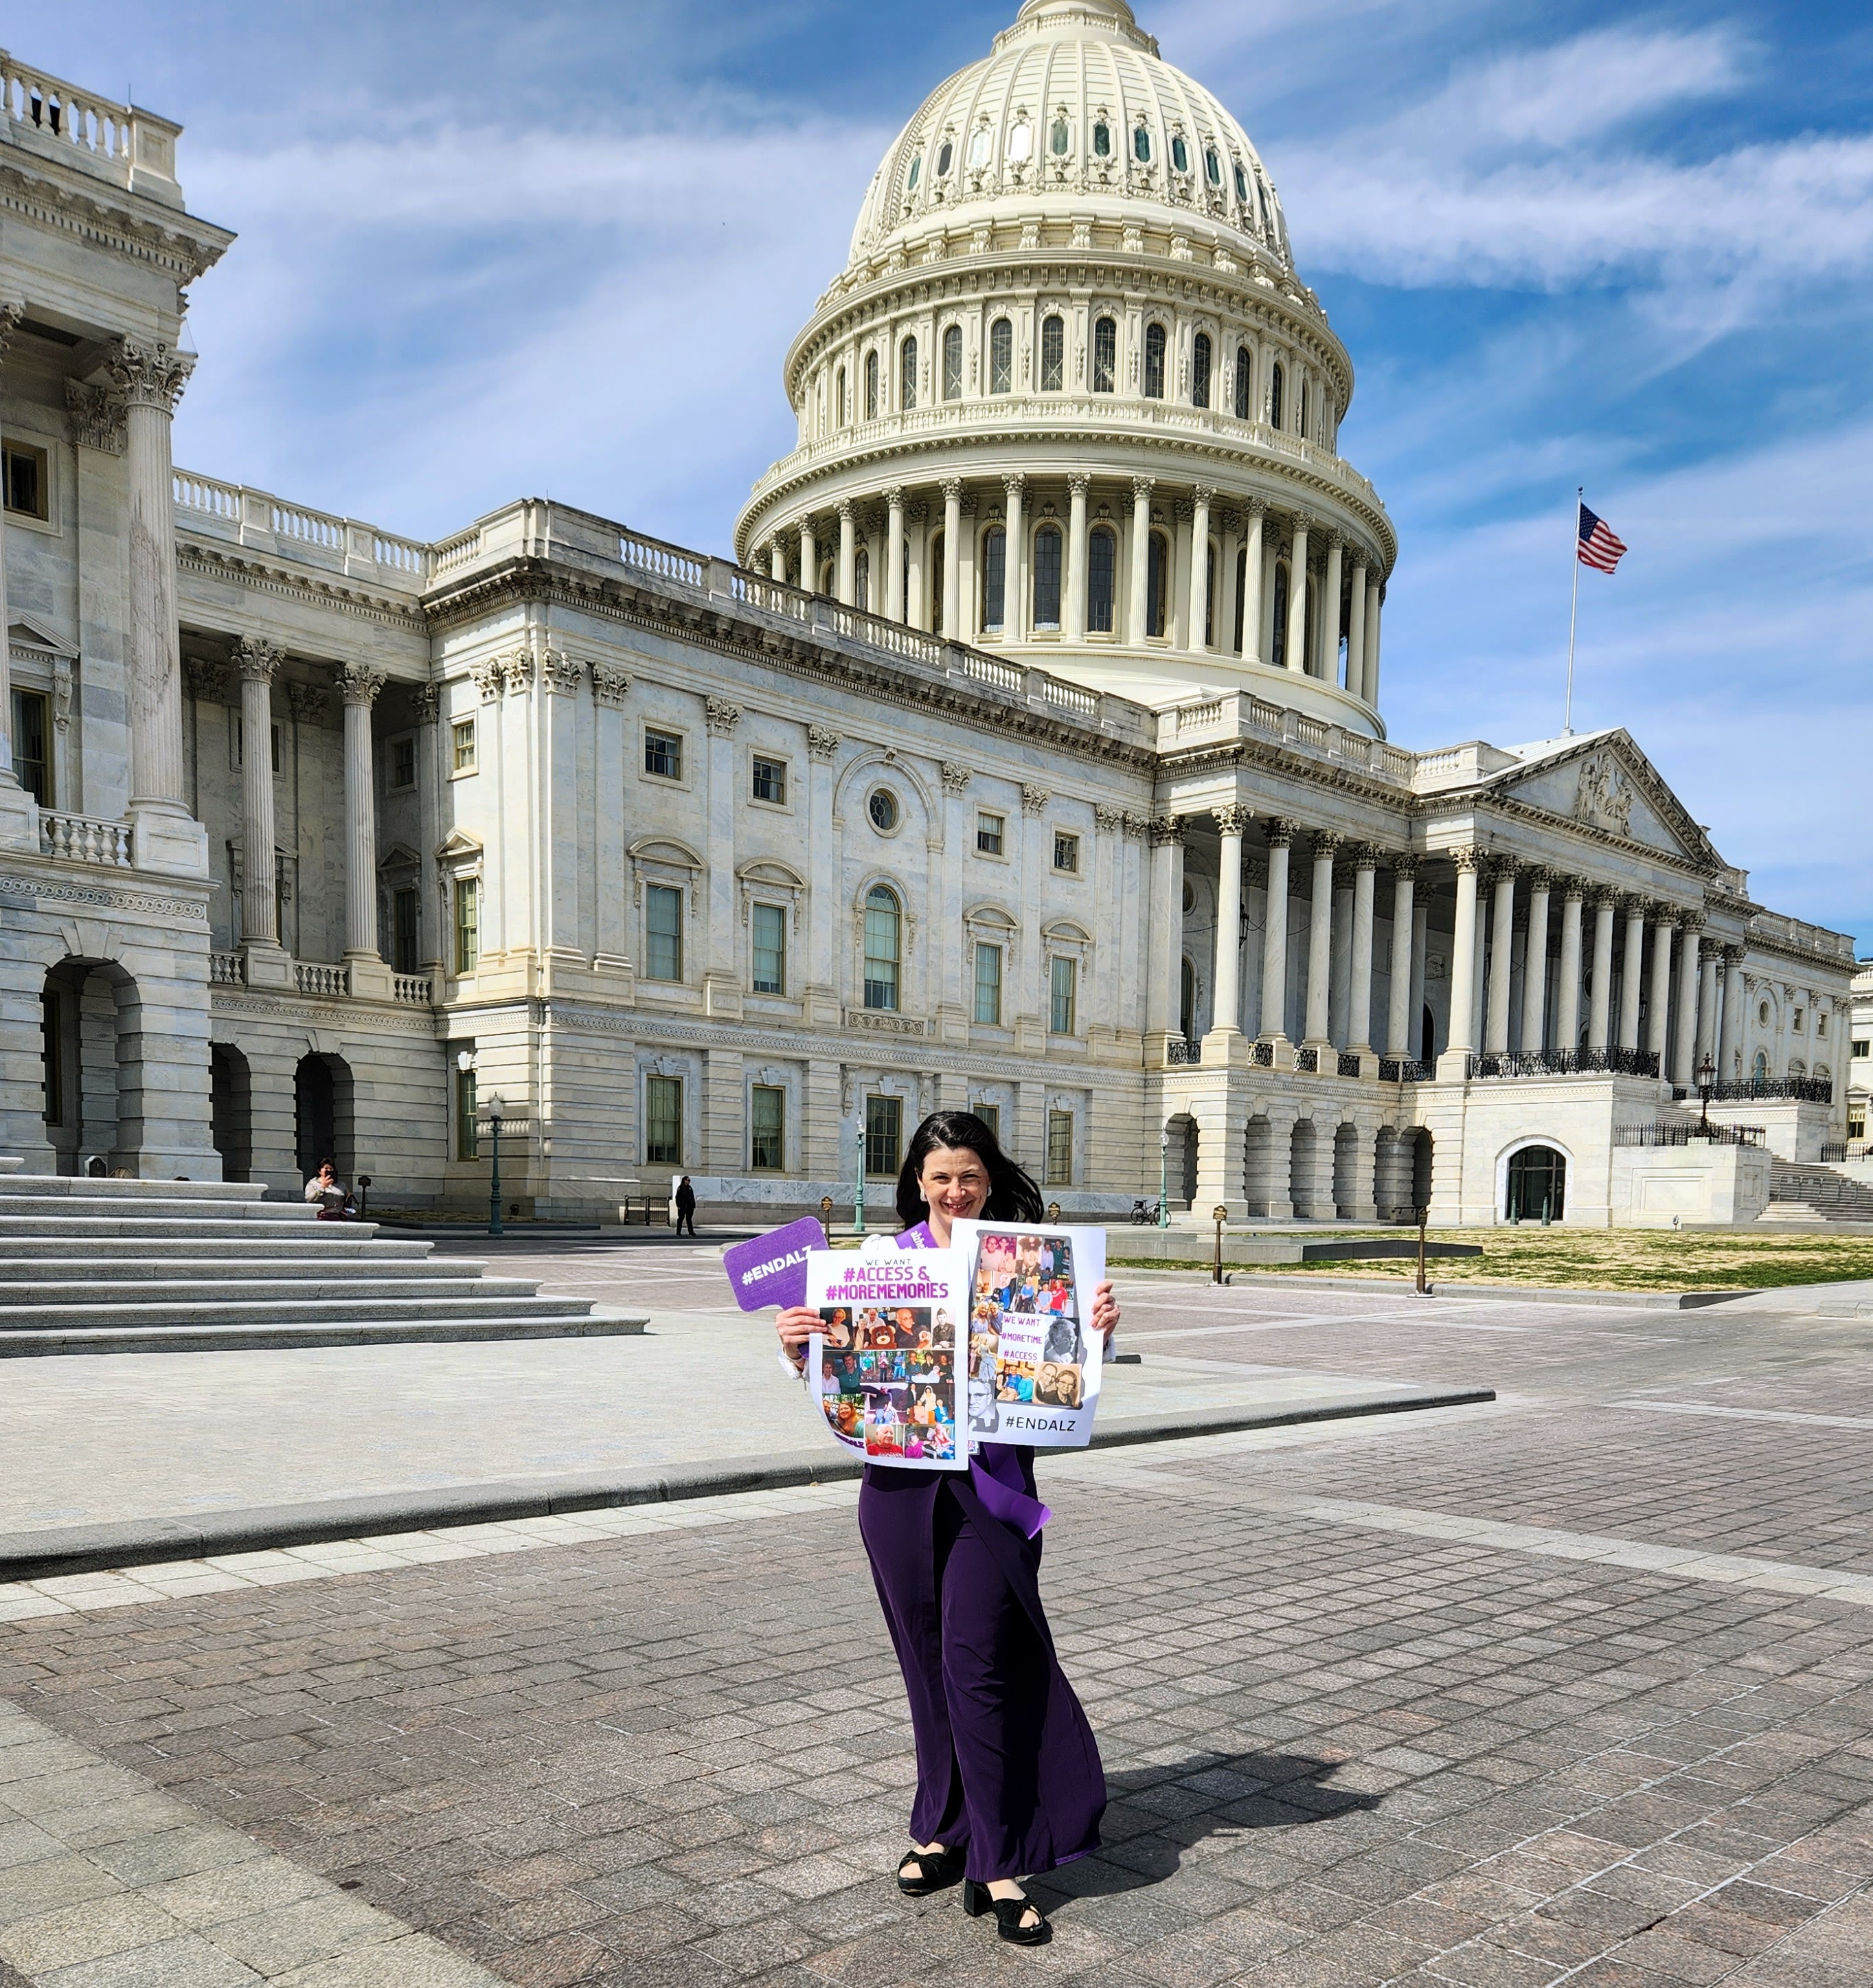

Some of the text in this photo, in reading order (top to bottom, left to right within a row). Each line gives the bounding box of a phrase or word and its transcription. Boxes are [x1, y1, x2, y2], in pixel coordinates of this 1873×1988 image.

[843, 1265, 931, 1283] #ACCESS &
[826, 1283, 949, 1300] #MOREMEMORIES
[1003, 1315, 1041, 1327] WE WANT
[1001, 1332, 1043, 1344] #MORETIME
[1003, 1350, 1038, 1361] #ACCESS
[1006, 1416, 1076, 1432] #ENDALZ
